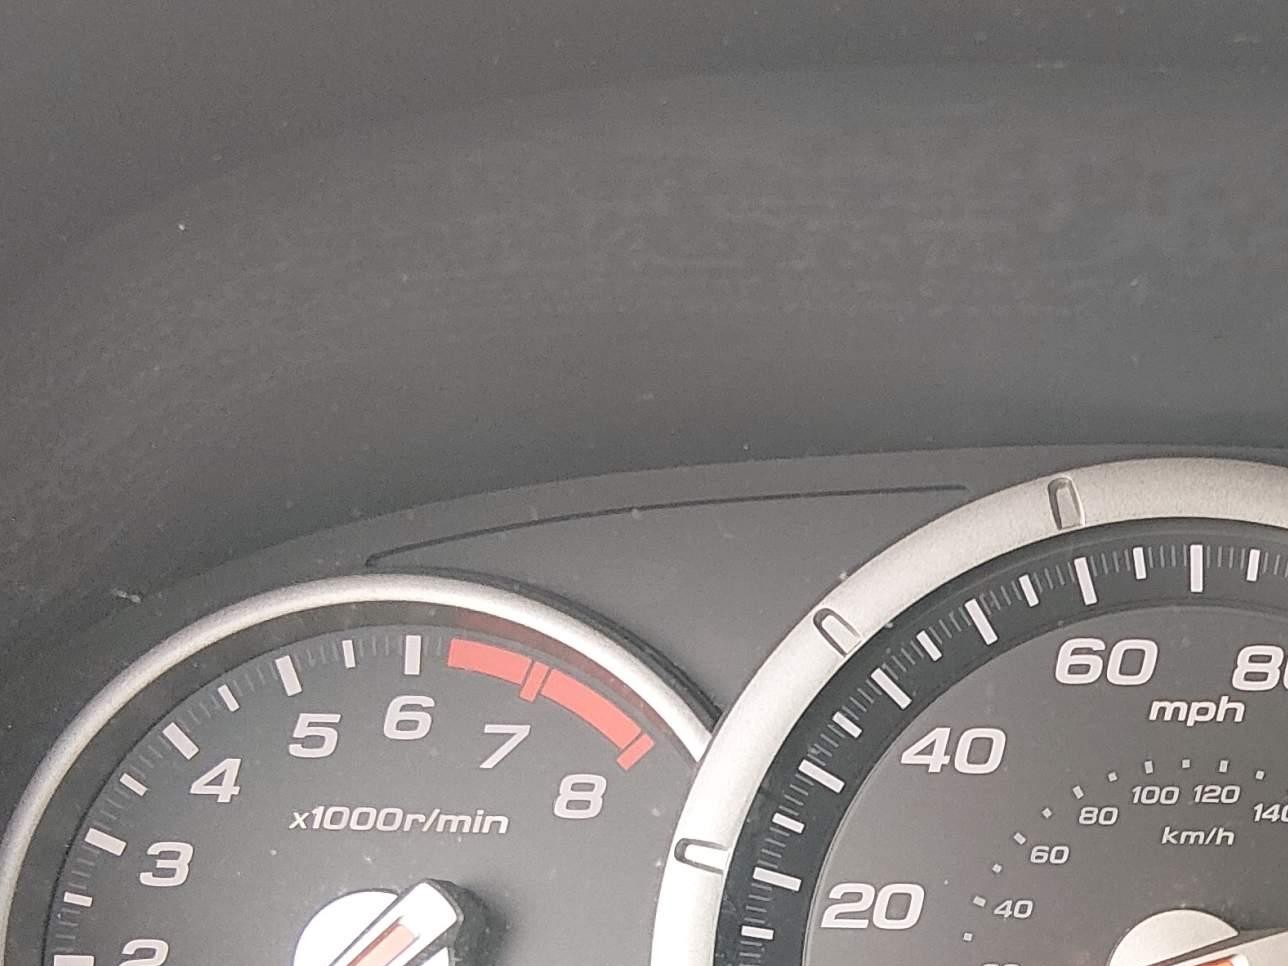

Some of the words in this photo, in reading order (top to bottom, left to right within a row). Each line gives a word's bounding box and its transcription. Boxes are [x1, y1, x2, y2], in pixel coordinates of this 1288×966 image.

[1055, 637, 1158, 686] 60
[383, 695, 435, 740] 6
[1148, 695, 1245, 727] mph
[288, 712, 341, 758] 5
[479, 724, 531, 769] 7
[900, 727, 1006, 774] 40
[189, 756, 242, 803] 4
[553, 773, 607, 819] 8
[1132, 786, 1180, 805] 100
[1193, 784, 1241, 804] 120
[288, 805, 509, 834] x1000r/min
[1078, 806, 1119, 825] 80
[1161, 826, 1235, 845] km/h
[139, 841, 194, 887] 3
[1030, 845, 1070, 864] 60
[820, 882, 925, 930] 20
[993, 899, 1033, 919] 40
